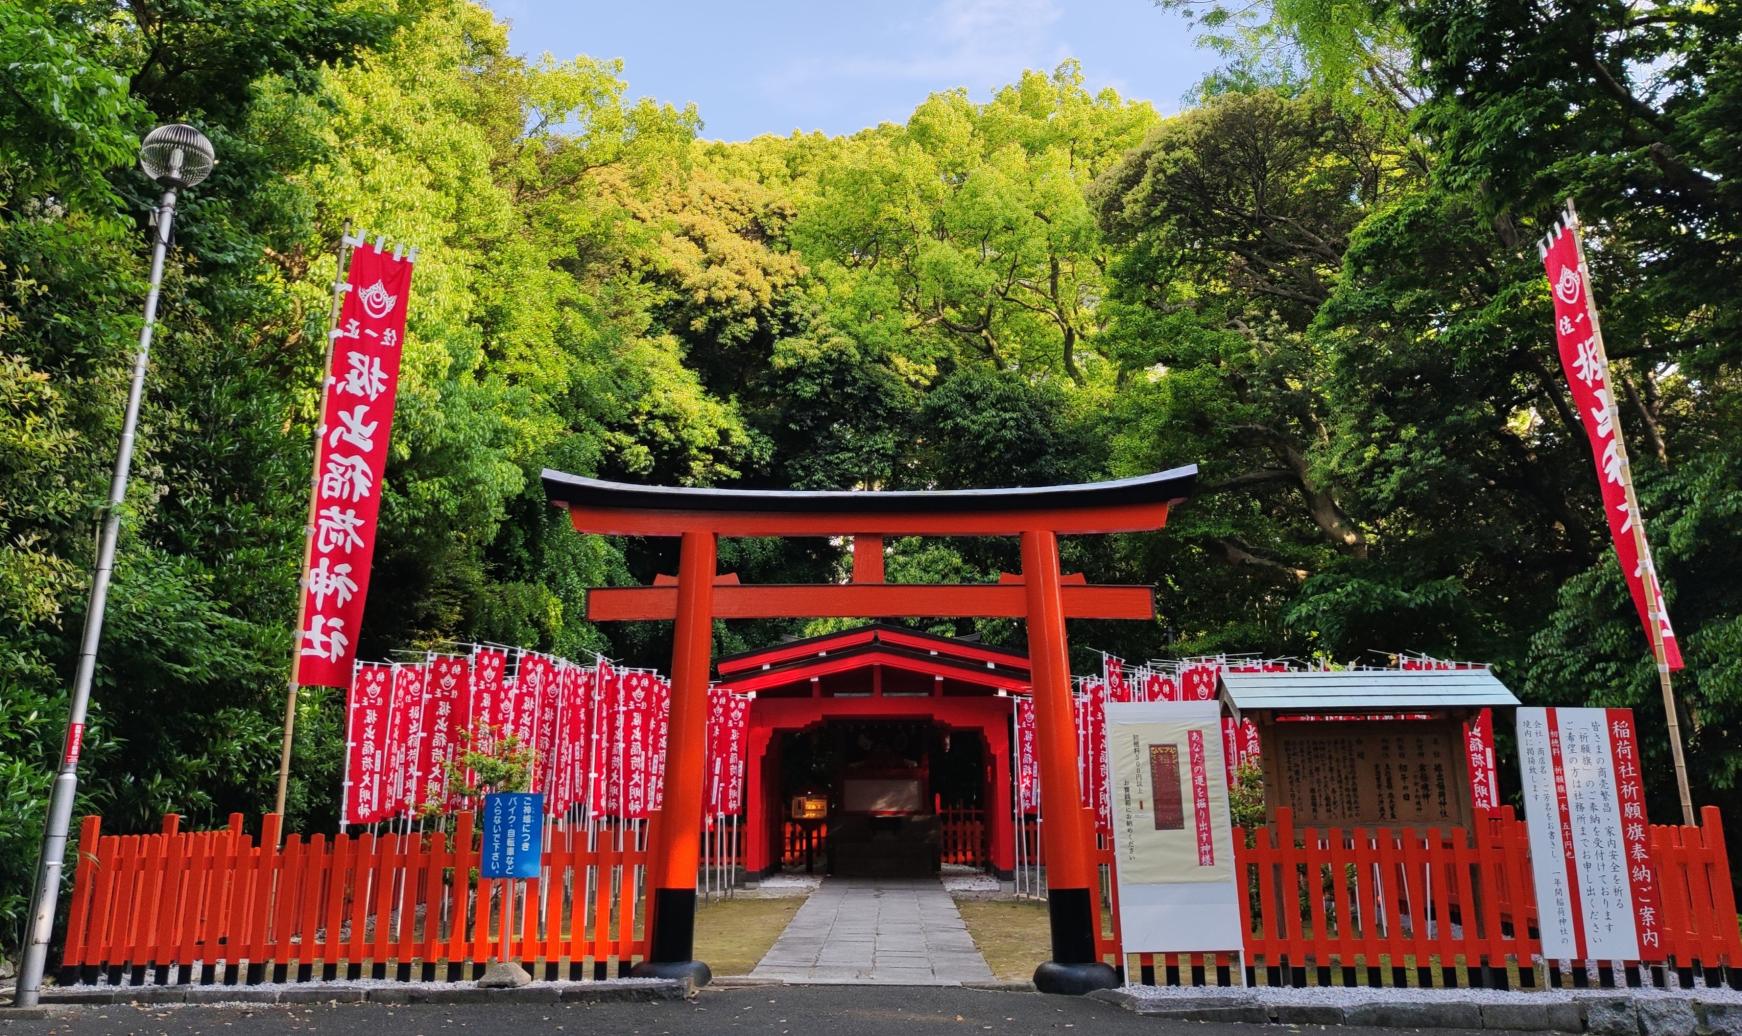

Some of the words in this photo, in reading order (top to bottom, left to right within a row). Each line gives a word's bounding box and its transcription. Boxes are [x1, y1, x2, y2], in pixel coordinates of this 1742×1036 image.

[1565, 721, 1603, 944] ご希望の方は社務所までお申し出ください
[1612, 720, 1659, 948] 稲荷社祈願旗奉納ご案内
